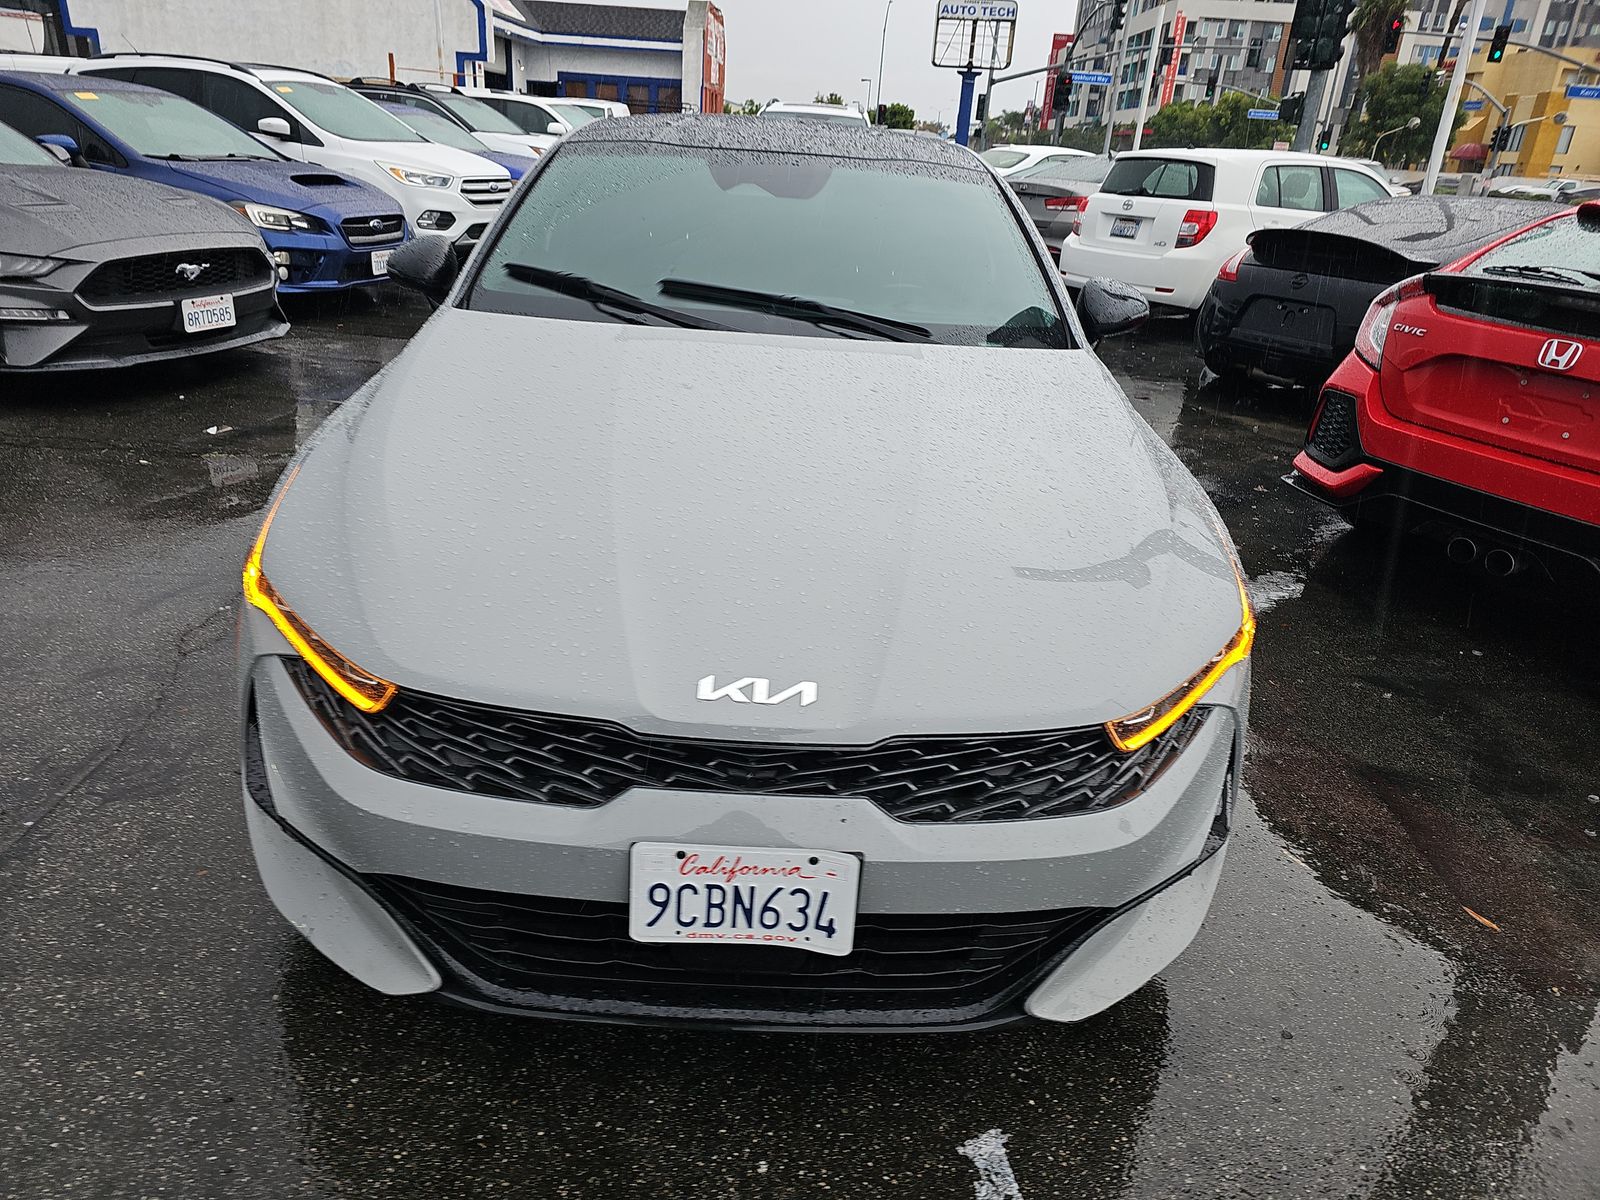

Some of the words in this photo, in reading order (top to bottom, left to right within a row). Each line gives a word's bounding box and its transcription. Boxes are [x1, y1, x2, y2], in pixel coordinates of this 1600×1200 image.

[941, 5, 976, 15] AUTO
[981, 7, 1015, 17] TECH
[187, 307, 231, 327] 8RTD585
[1393, 323, 1427, 337] CIVIC
[697, 674, 818, 707] KIA
[680, 854, 817, 882] California
[646, 882, 837, 939] 9CBN634
